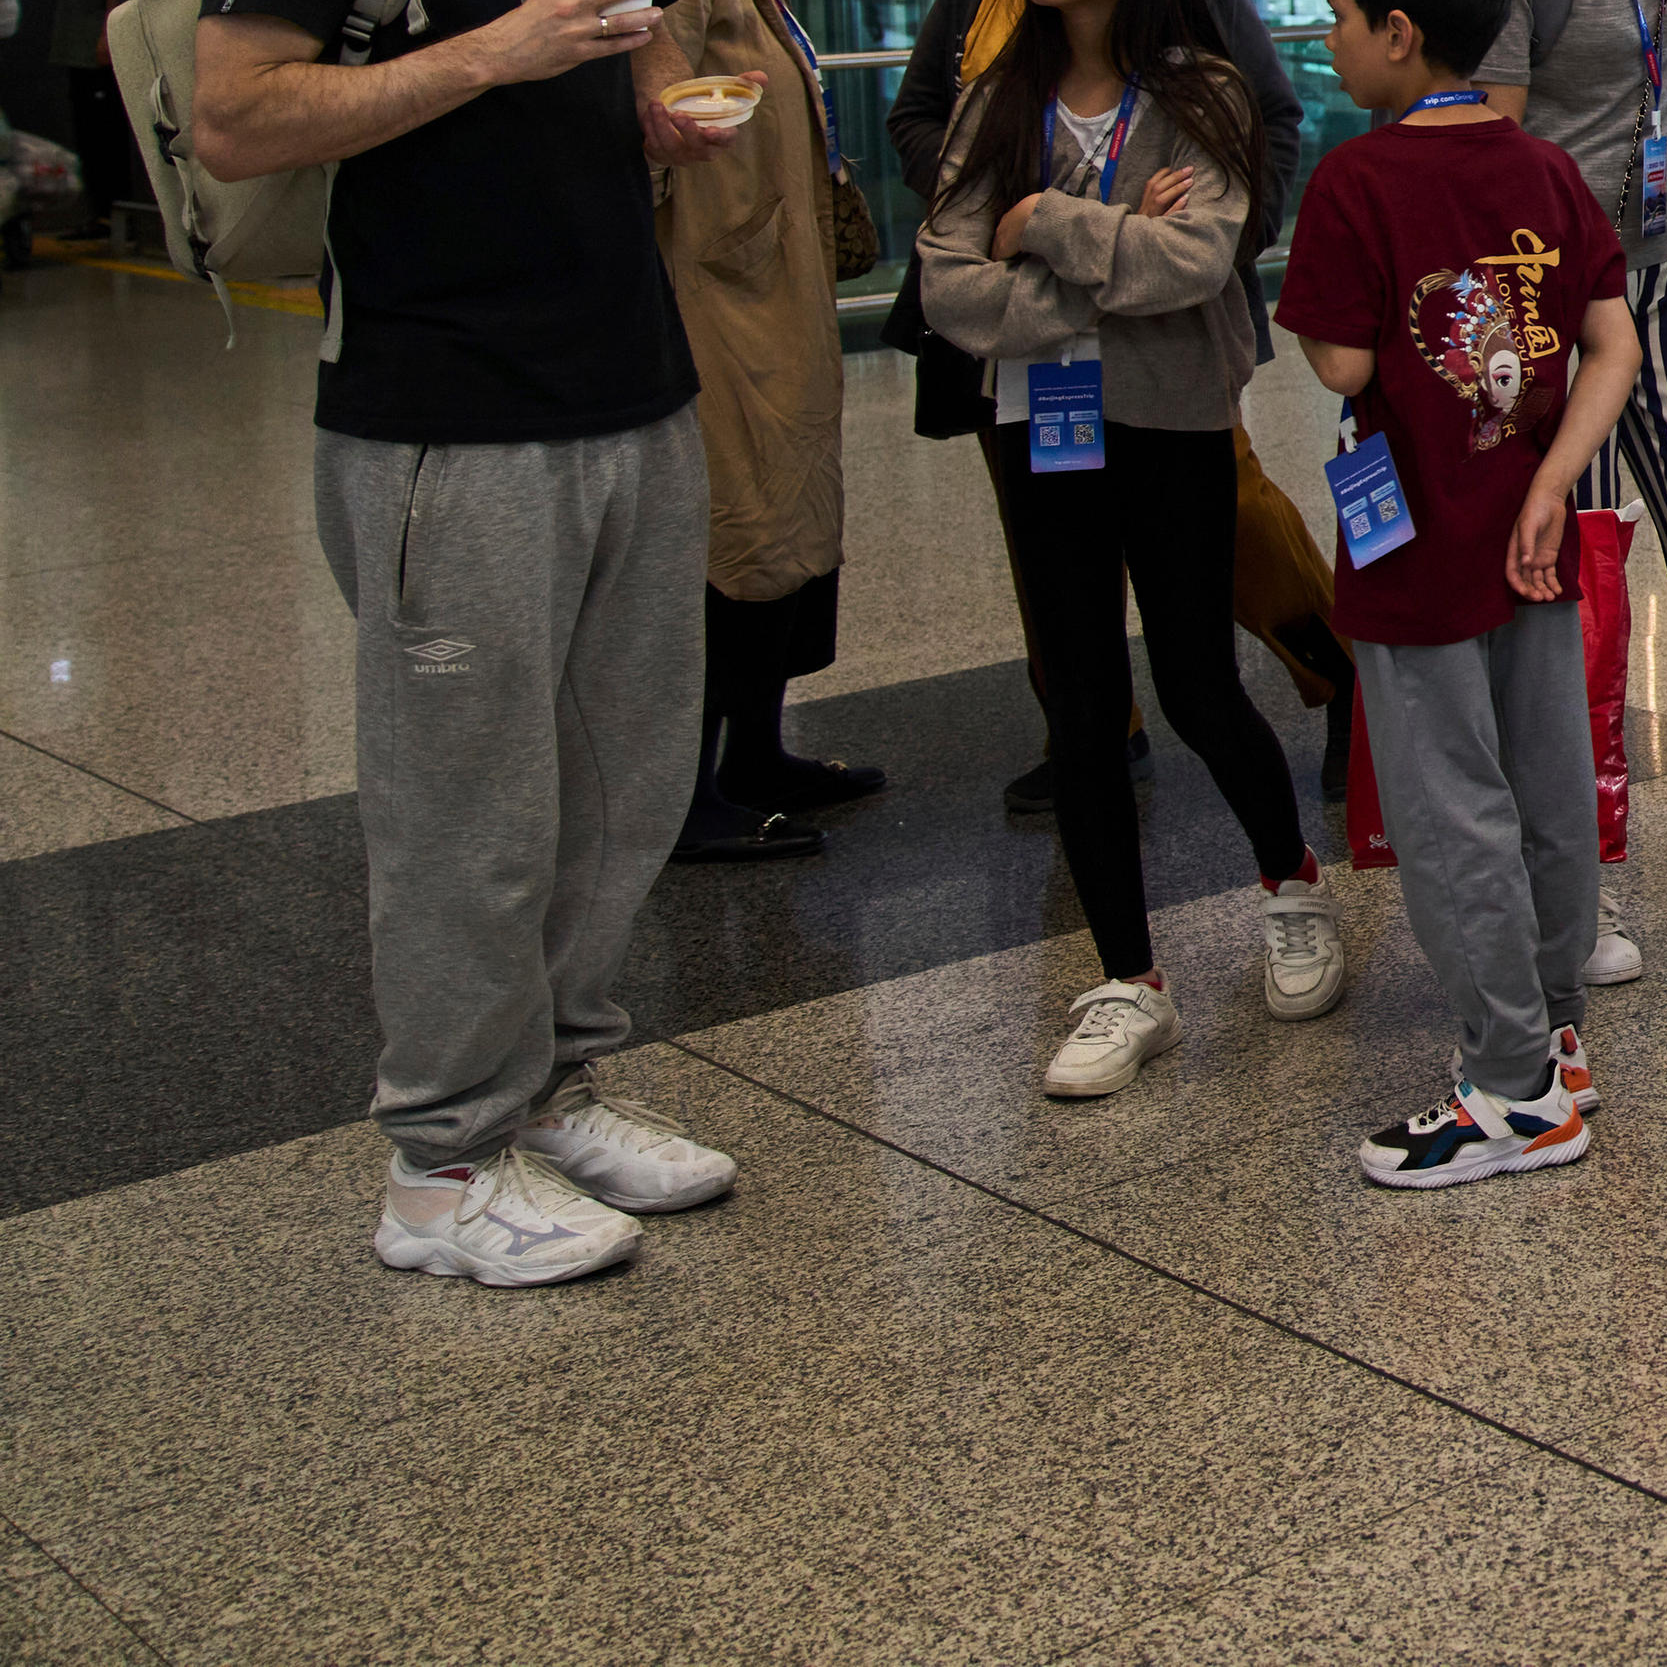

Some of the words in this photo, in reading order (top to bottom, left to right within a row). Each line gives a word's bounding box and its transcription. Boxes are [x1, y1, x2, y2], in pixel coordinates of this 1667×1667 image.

[1424, 95, 1455, 105] Trip.com
[1495, 273, 1516, 320] LOVE
[1511, 324, 1531, 362] YOU
[413, 661, 470, 676] umbro
